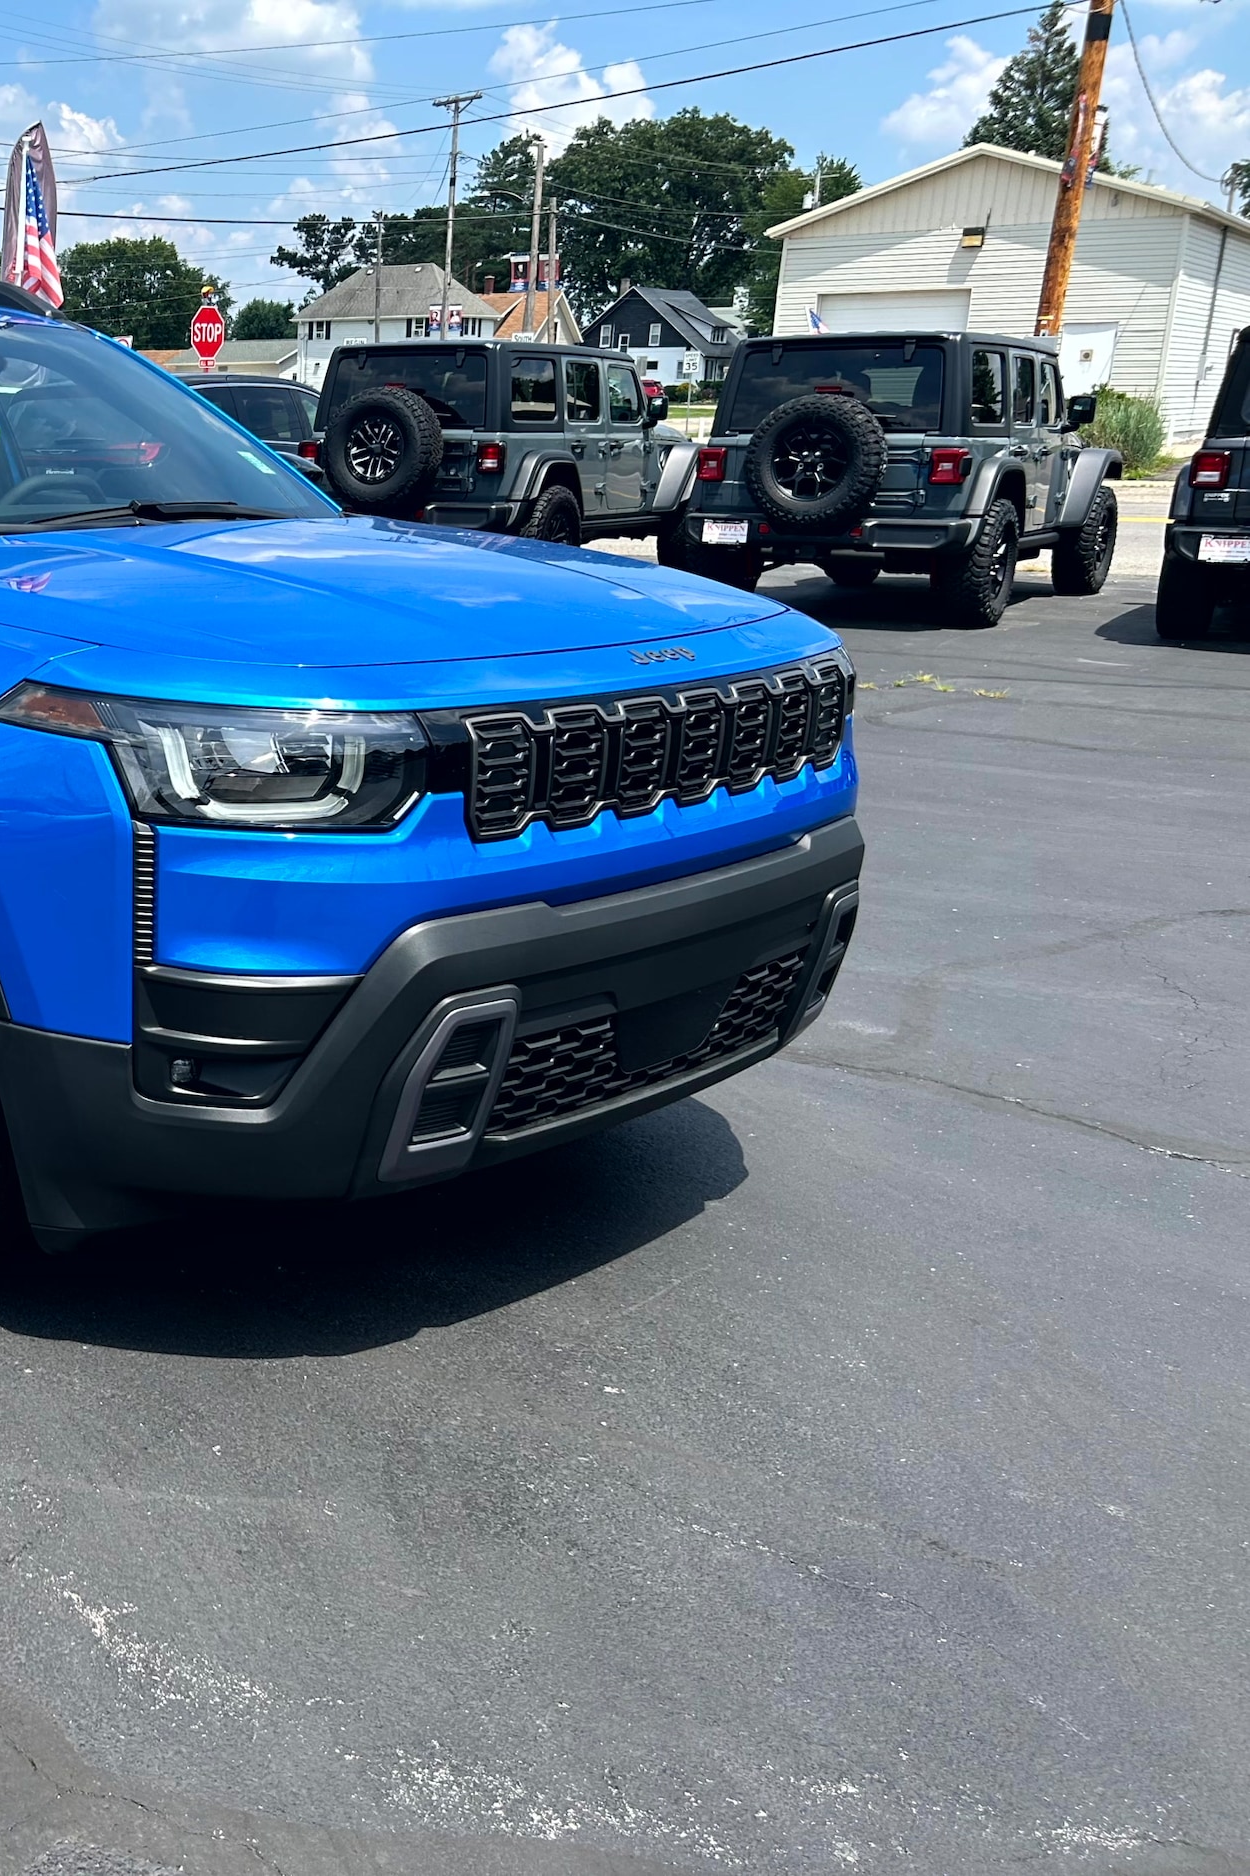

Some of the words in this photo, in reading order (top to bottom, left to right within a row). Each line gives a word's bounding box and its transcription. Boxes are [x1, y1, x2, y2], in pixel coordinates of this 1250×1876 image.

[193, 322, 222, 343] STOP
[685, 362, 698, 371] 35
[707, 523, 746, 532] KNIPPEN
[1205, 539, 1250, 549] KNIPPE
[627, 647, 696, 665] Jeep
